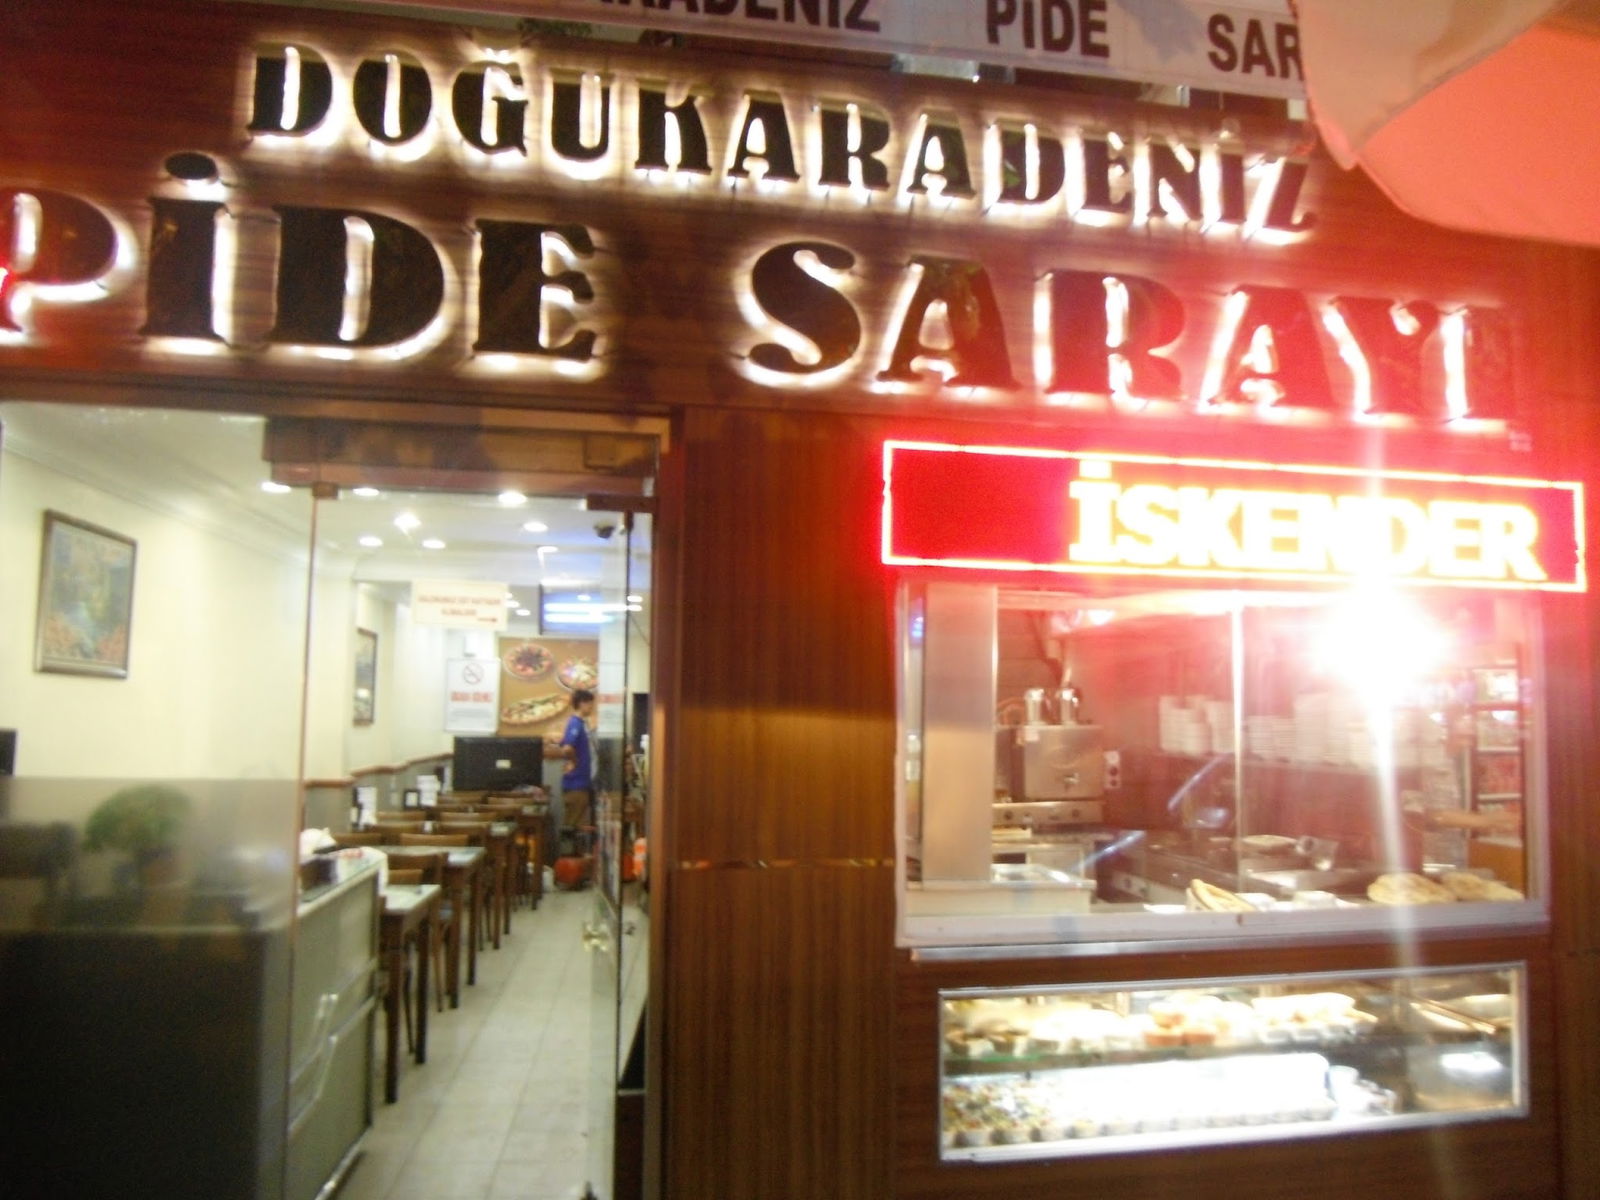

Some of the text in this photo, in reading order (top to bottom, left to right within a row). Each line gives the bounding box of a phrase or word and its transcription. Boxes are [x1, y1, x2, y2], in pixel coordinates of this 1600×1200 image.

[0, 152, 1512, 424] PİDE SARAYI
[1069, 459, 1548, 581] İSKENDER
